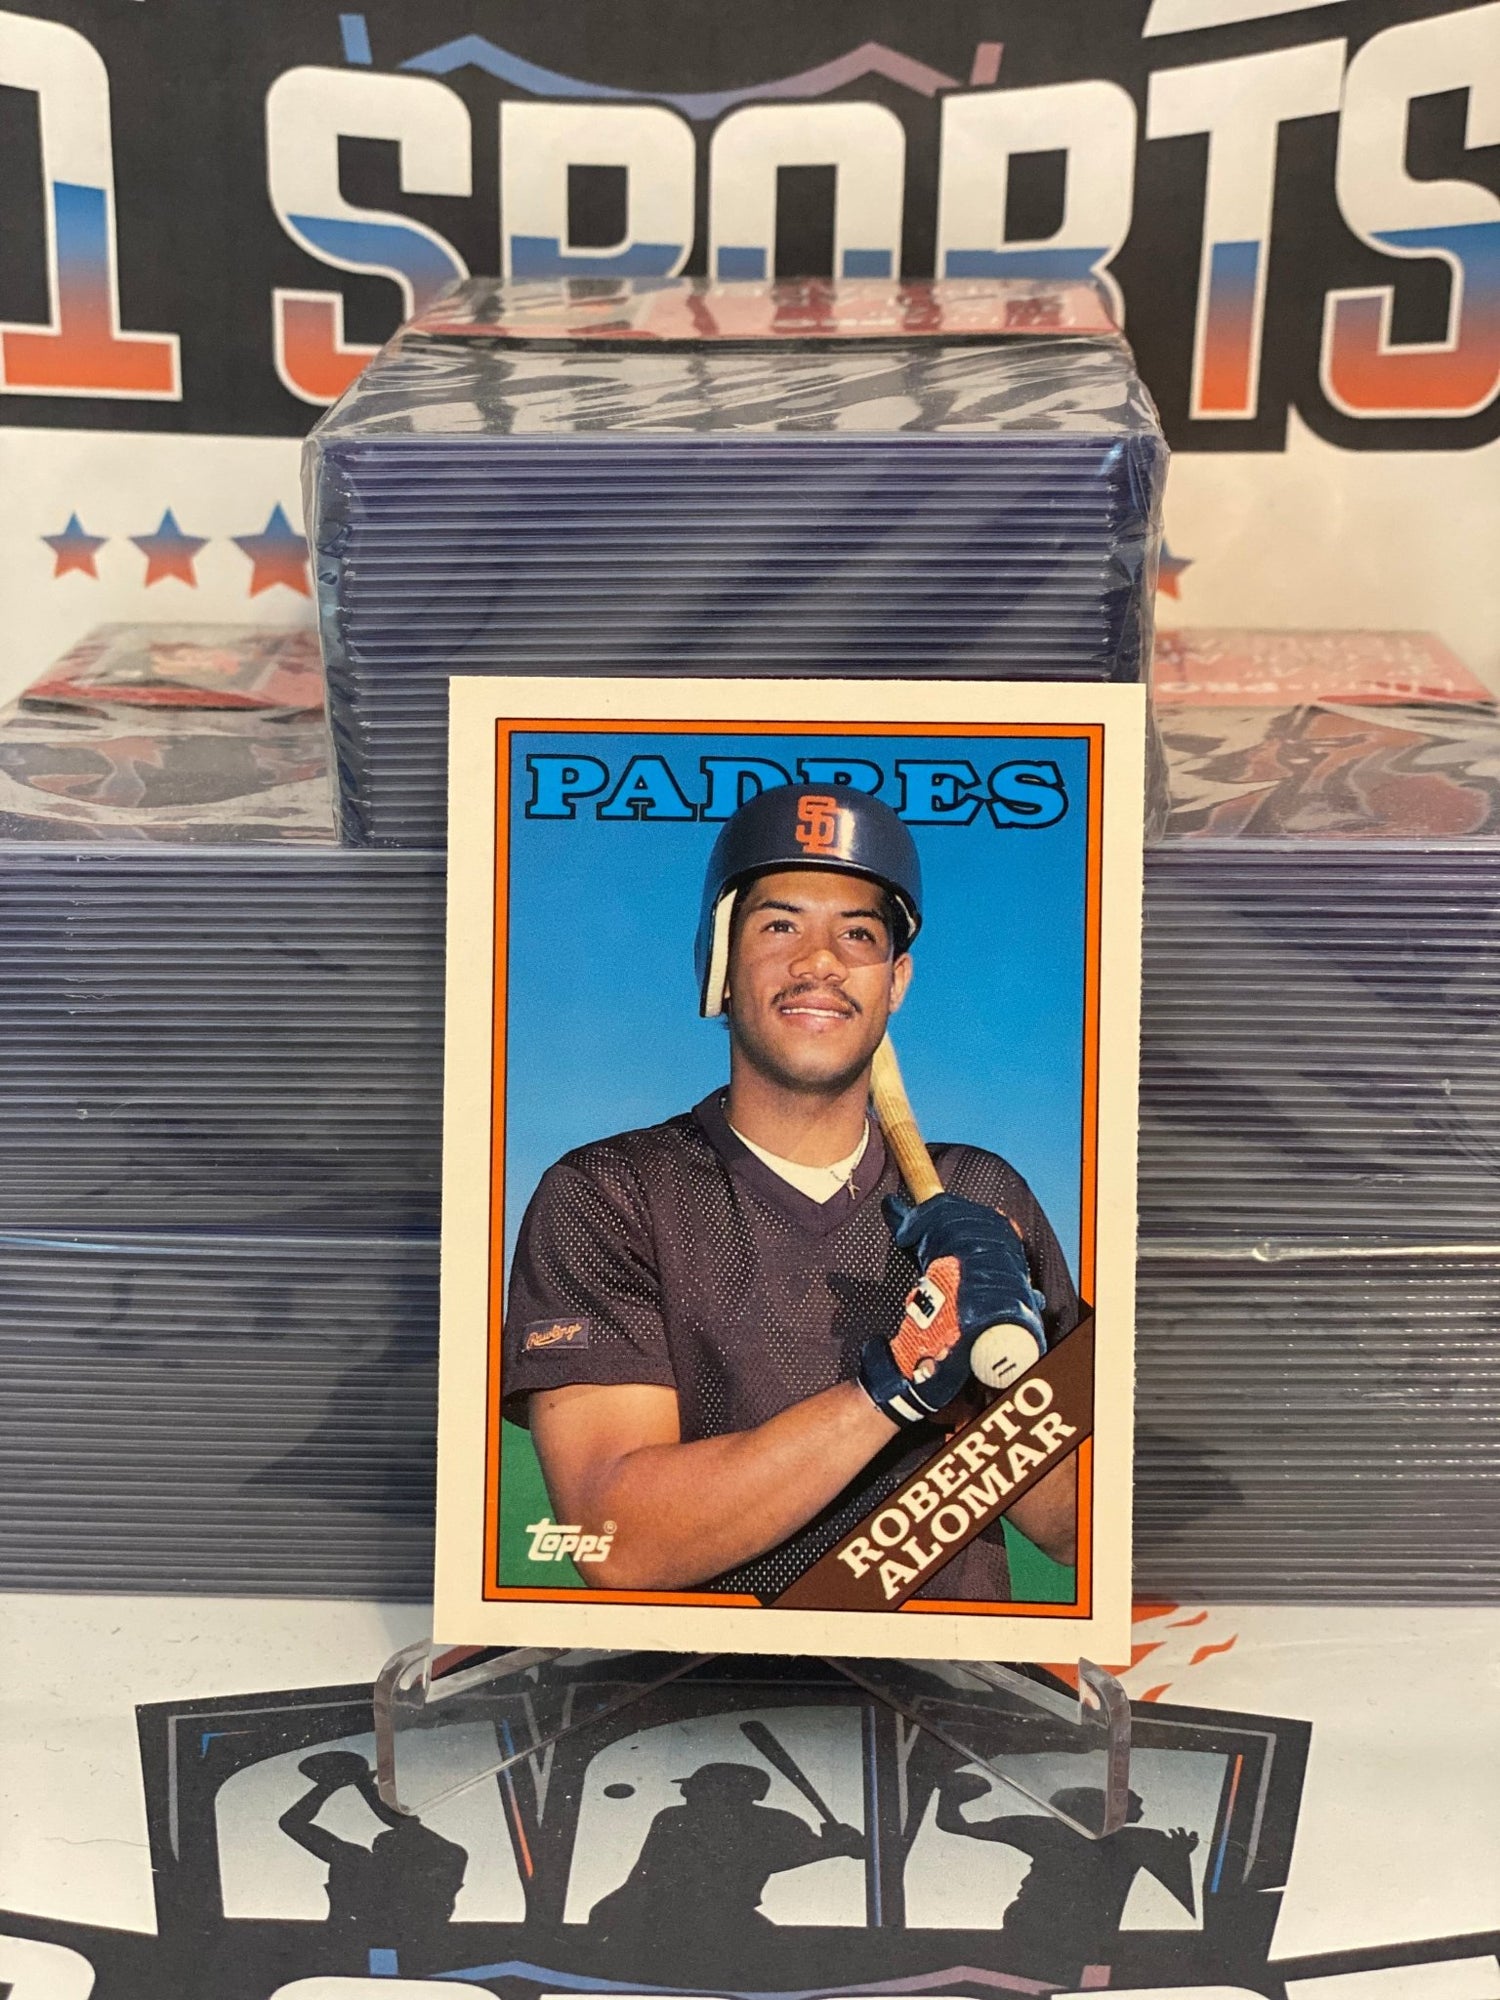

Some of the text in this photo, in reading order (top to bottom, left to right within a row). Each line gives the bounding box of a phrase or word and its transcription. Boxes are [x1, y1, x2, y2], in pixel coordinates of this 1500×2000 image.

[266, 8, 1500, 420] SPORTS
[837, 1378, 1054, 1579] ROBERTO
[877, 1412, 1077, 1600] ALOMAR
